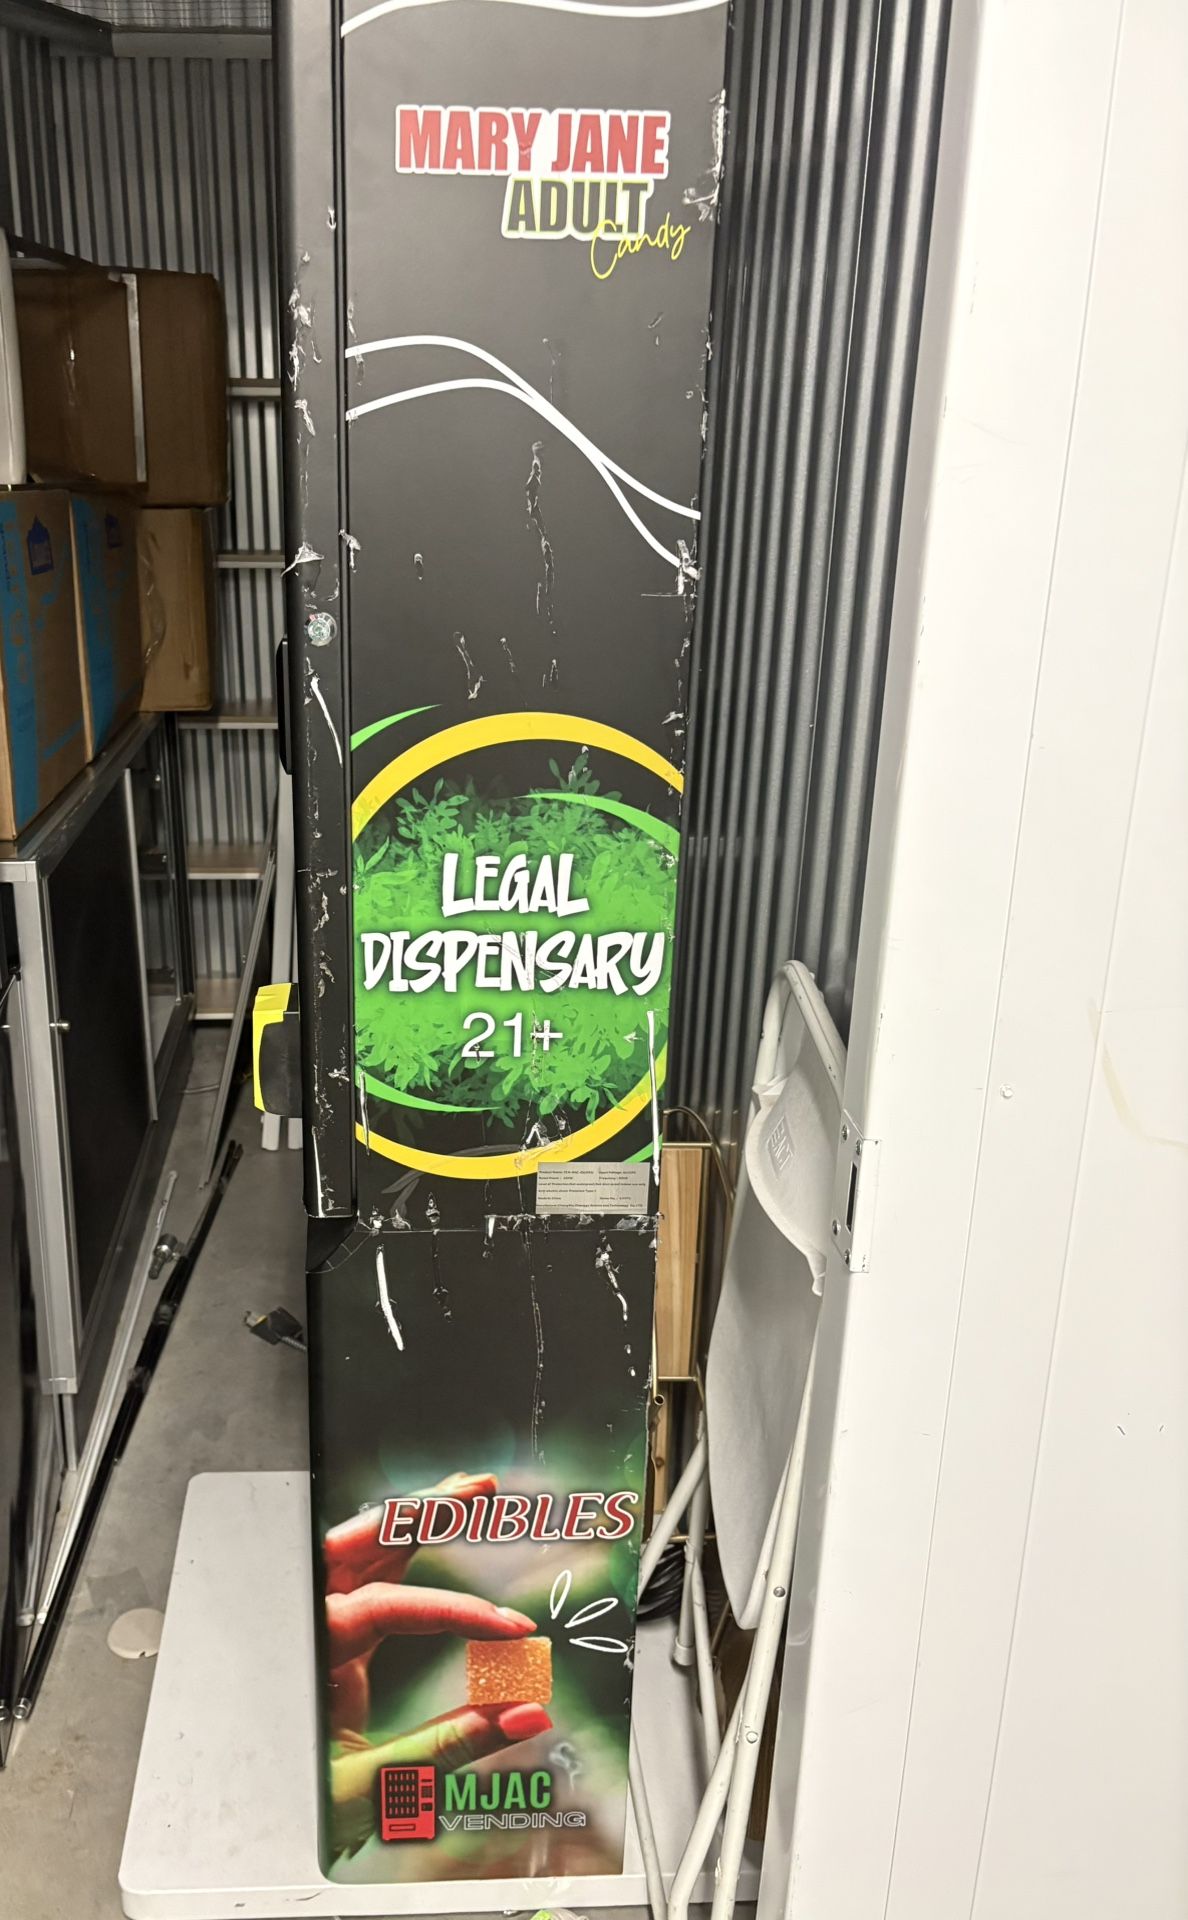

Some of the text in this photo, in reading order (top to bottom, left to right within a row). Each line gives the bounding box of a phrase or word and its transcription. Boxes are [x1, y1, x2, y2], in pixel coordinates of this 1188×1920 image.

[398, 108, 667, 175] MARY JANE
[506, 178, 649, 235] ADULT
[589, 211, 692, 280] Candy
[441, 852, 590, 918] LEGAL
[360, 930, 666, 997] DISPENSARY
[460, 1011, 564, 1059] 21+
[379, 1491, 639, 1545] EDIBLES
[444, 1771, 552, 1812] MJAC
[438, 1811, 587, 1832] VENDING
